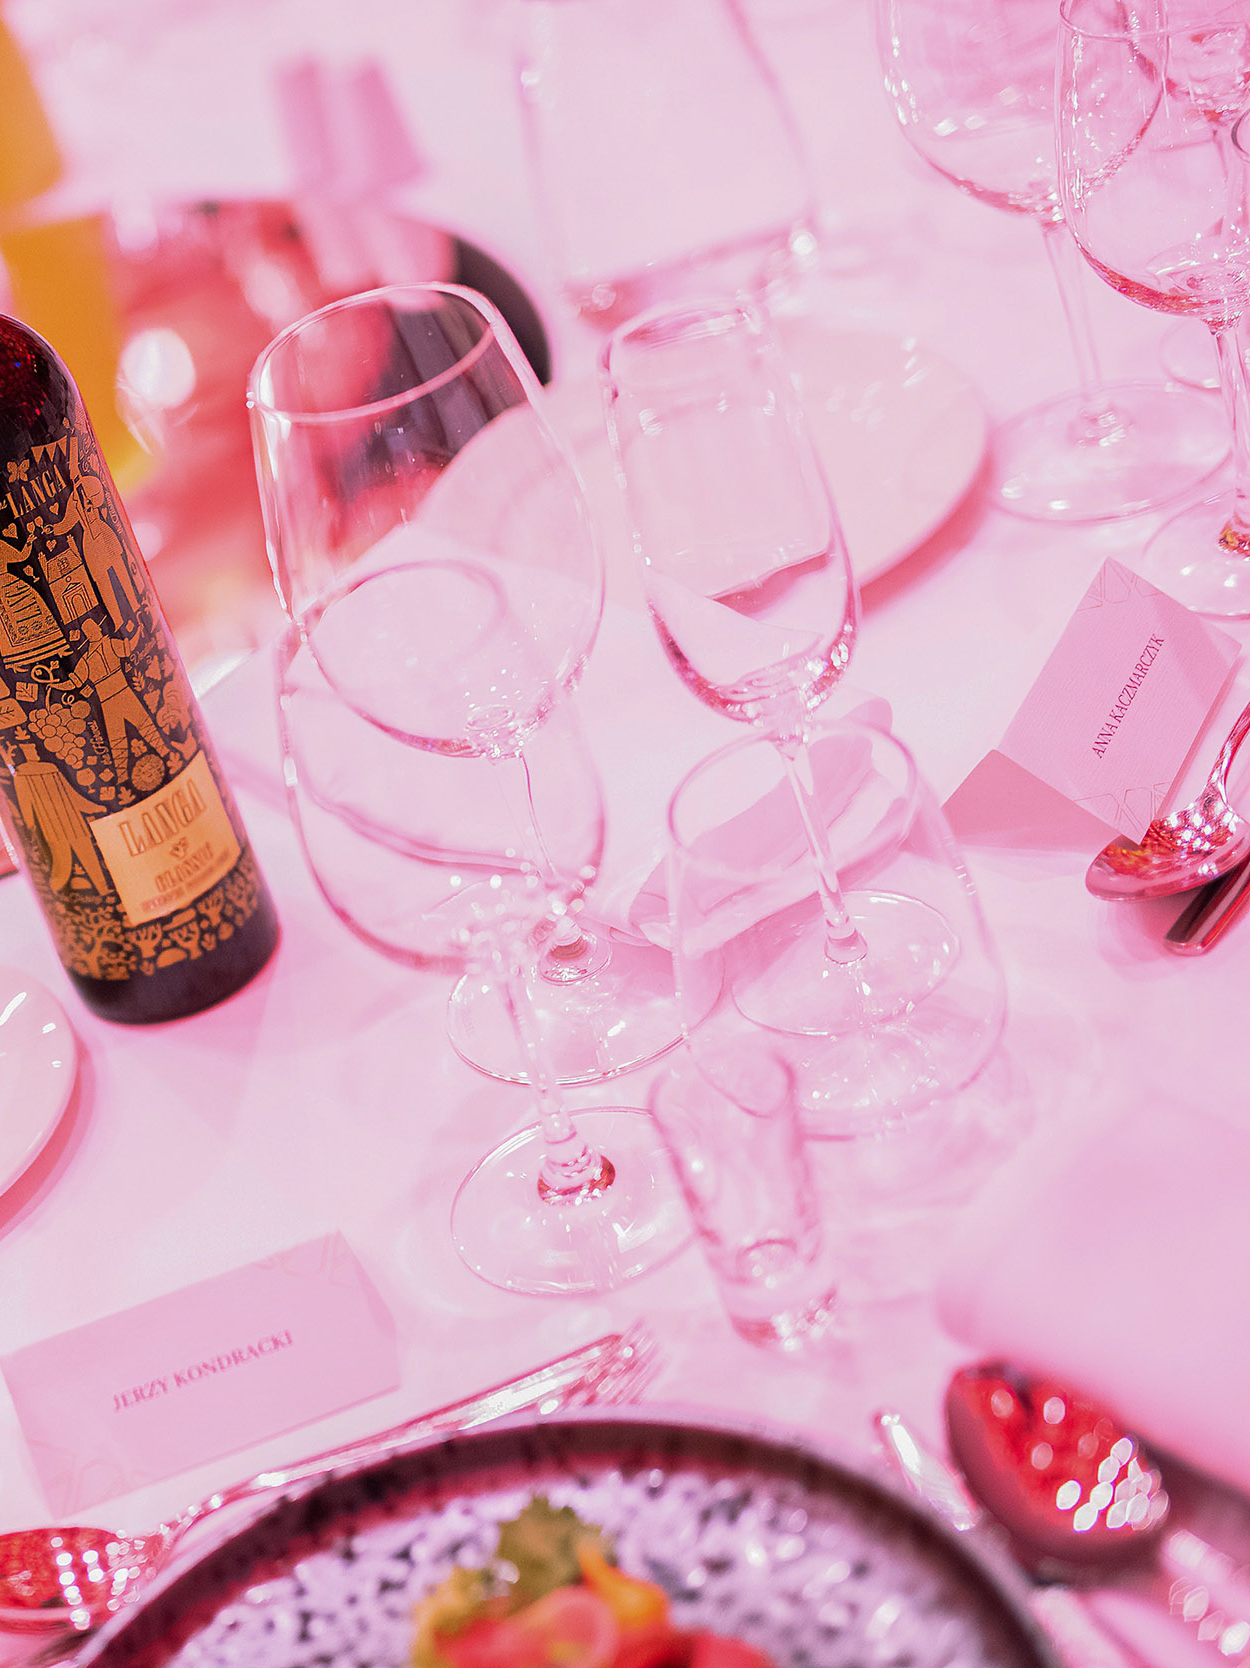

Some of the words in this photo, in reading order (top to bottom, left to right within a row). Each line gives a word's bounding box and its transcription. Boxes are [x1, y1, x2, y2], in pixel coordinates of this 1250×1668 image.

[6, 464, 66, 519] LANGA
[1092, 722, 1118, 758] ANNA
[1109, 633, 1165, 723] KACZMARCZYK
[112, 1379, 168, 1412] JERZY
[173, 1329, 293, 1387] KONDRACKI
